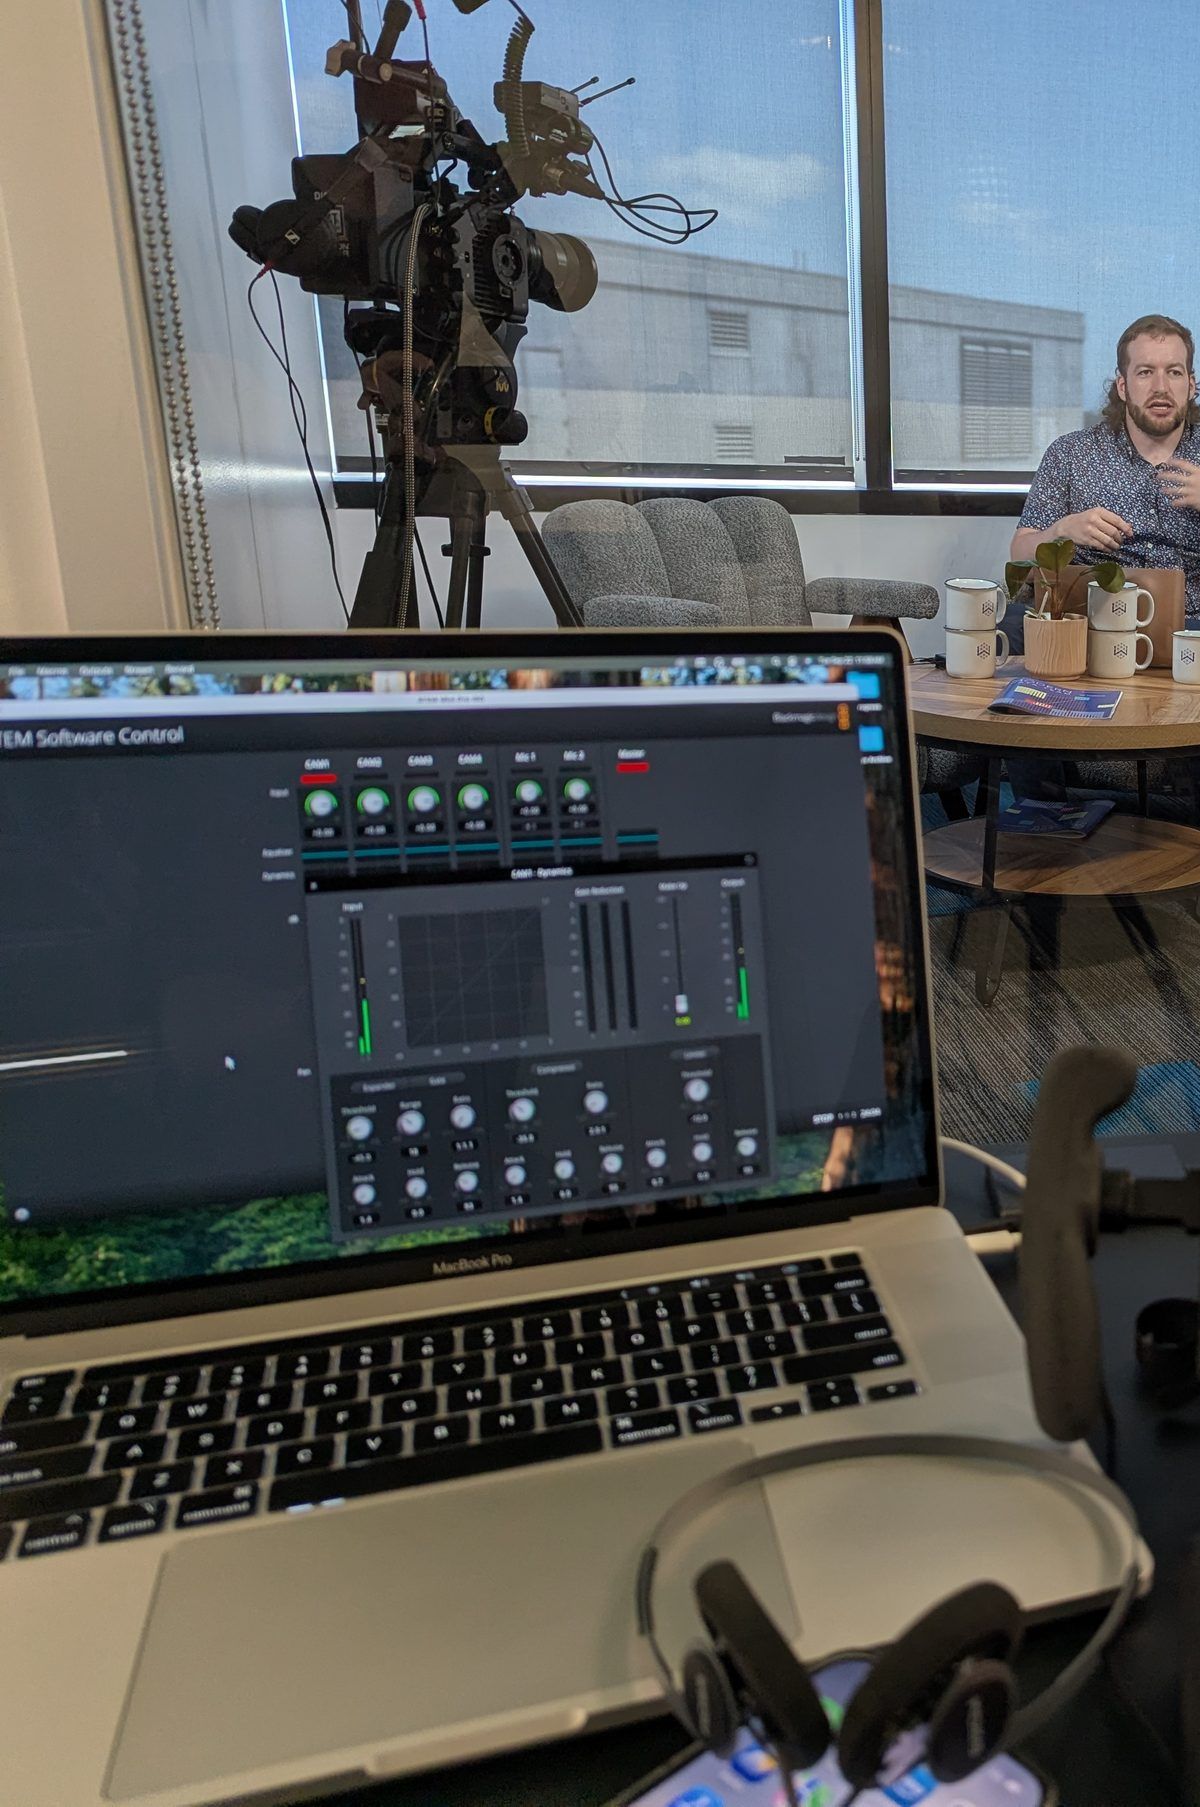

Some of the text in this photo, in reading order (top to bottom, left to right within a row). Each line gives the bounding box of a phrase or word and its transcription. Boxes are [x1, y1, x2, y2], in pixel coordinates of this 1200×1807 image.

[36, 728, 115, 748] Software
[118, 725, 184, 745] Control
[433, 1253, 512, 1274] MacBook Pro
[687, 1323, 701, 1336] P
[630, 1332, 645, 1345] O
[512, 1352, 527, 1365] U
[452, 1362, 466, 1375] Y
[532, 1378, 543, 1391] J
[466, 1388, 482, 1401] H
[187, 1404, 208, 1419] W
[562, 1401, 580, 1416] M
[365, 1436, 382, 1451] V
